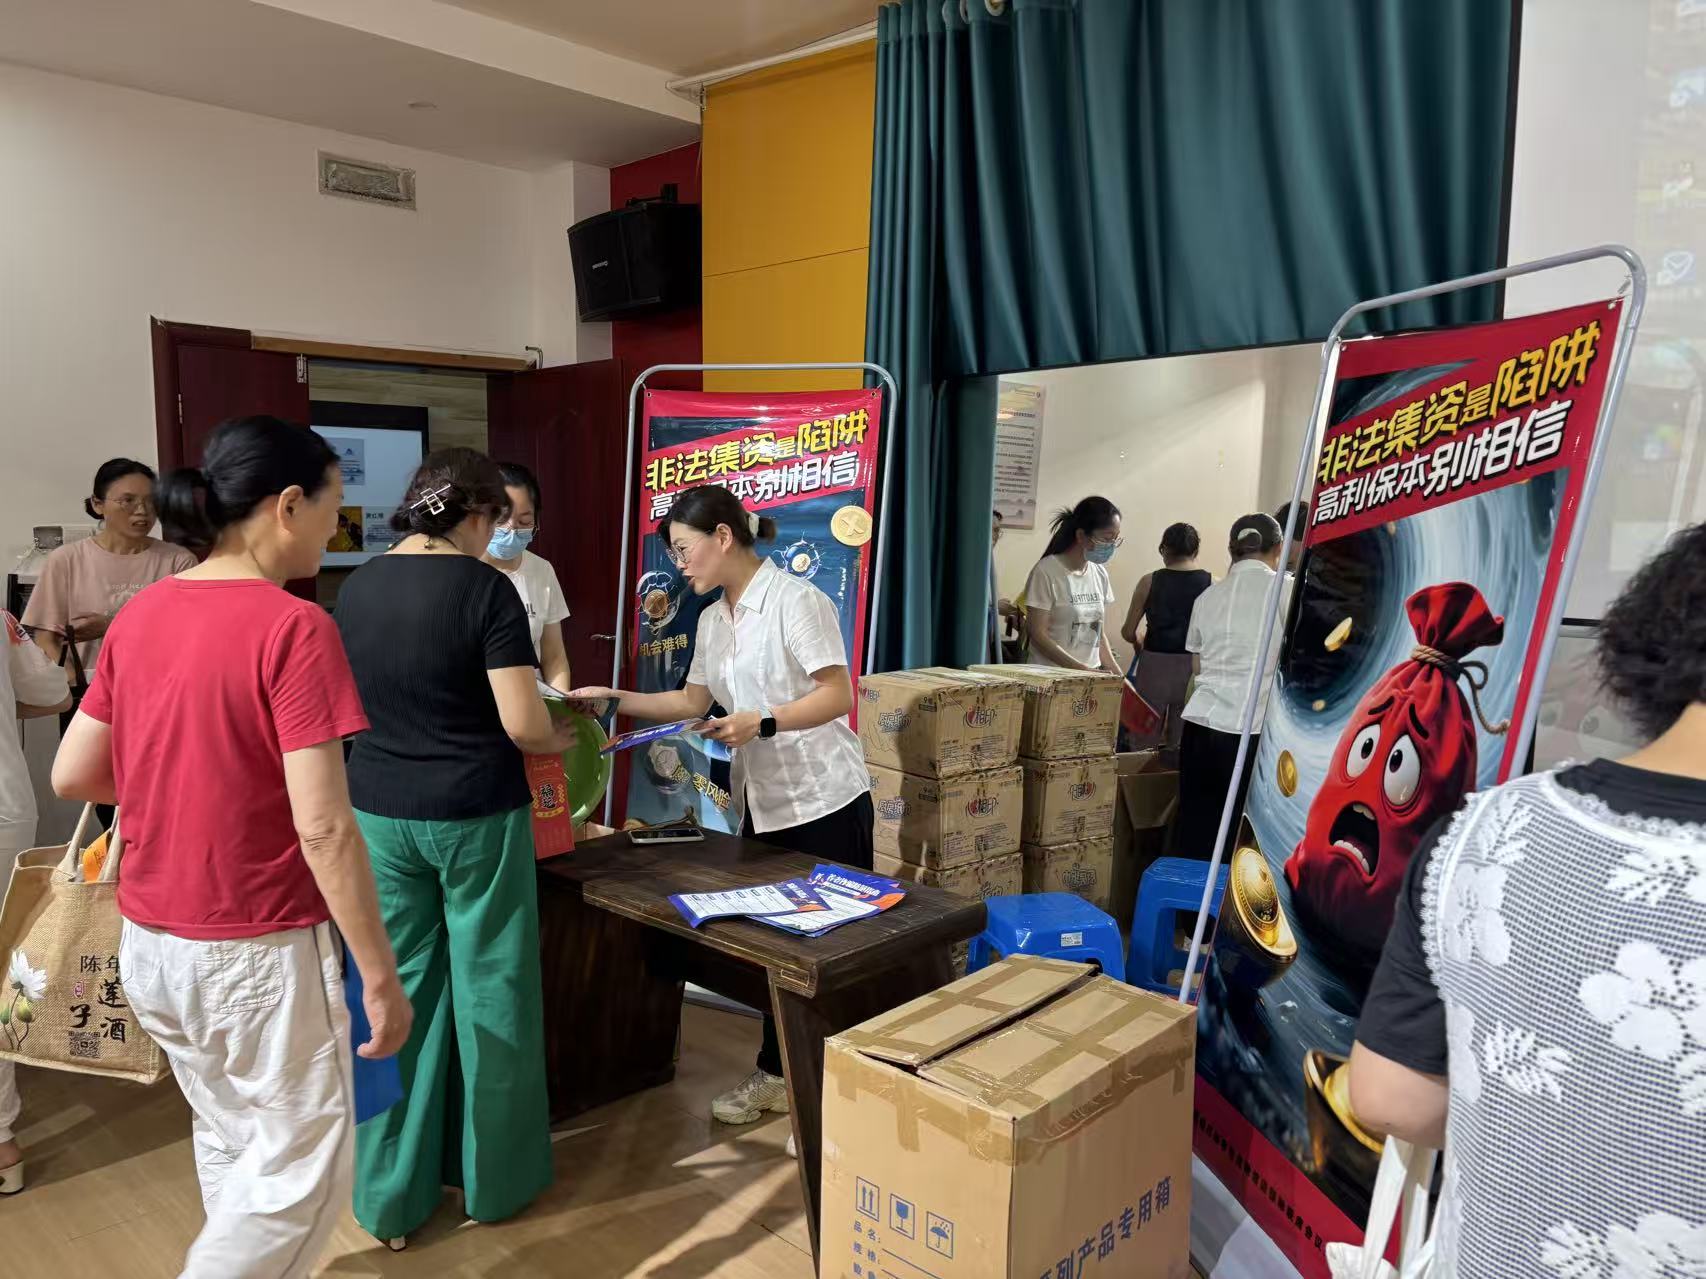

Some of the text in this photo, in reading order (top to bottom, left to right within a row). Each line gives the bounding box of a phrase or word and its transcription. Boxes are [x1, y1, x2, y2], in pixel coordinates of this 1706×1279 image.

[1317, 321, 1600, 484] 非法集资是陷阱
[645, 409, 869, 490] 非法集资是陷阱
[650, 451, 858, 521] 高本别相信
[1312, 400, 1572, 526] 高利保本别相信
[640, 633, 688, 656] 机会难得
[80, 955, 120, 973] 陈年
